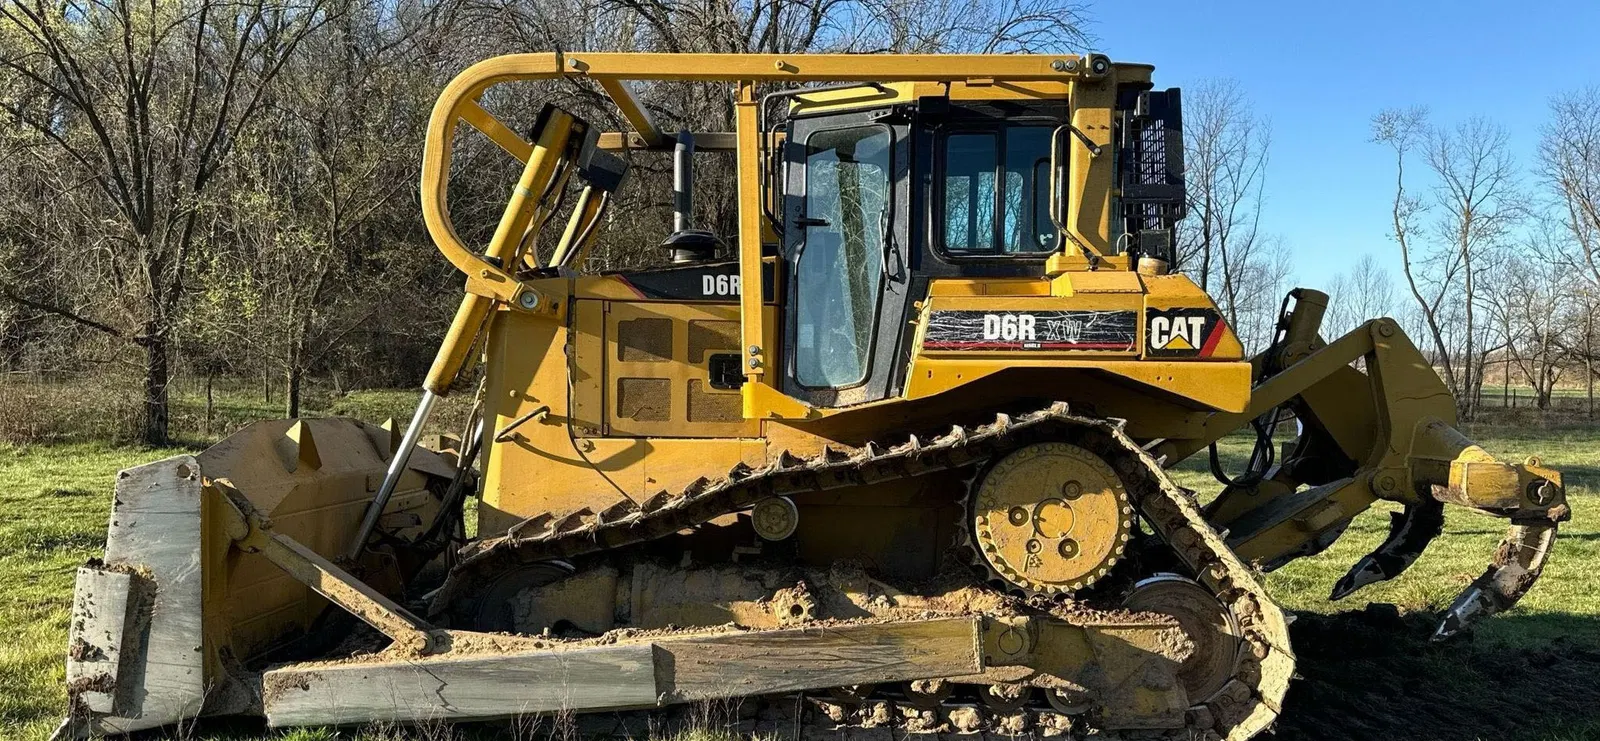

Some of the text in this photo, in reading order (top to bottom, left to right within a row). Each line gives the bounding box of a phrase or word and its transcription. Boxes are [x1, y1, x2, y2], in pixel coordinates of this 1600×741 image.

[702, 274, 741, 296] D6R
[984, 314, 1082, 340] D6R XW
[1151, 316, 1205, 350] CAT
